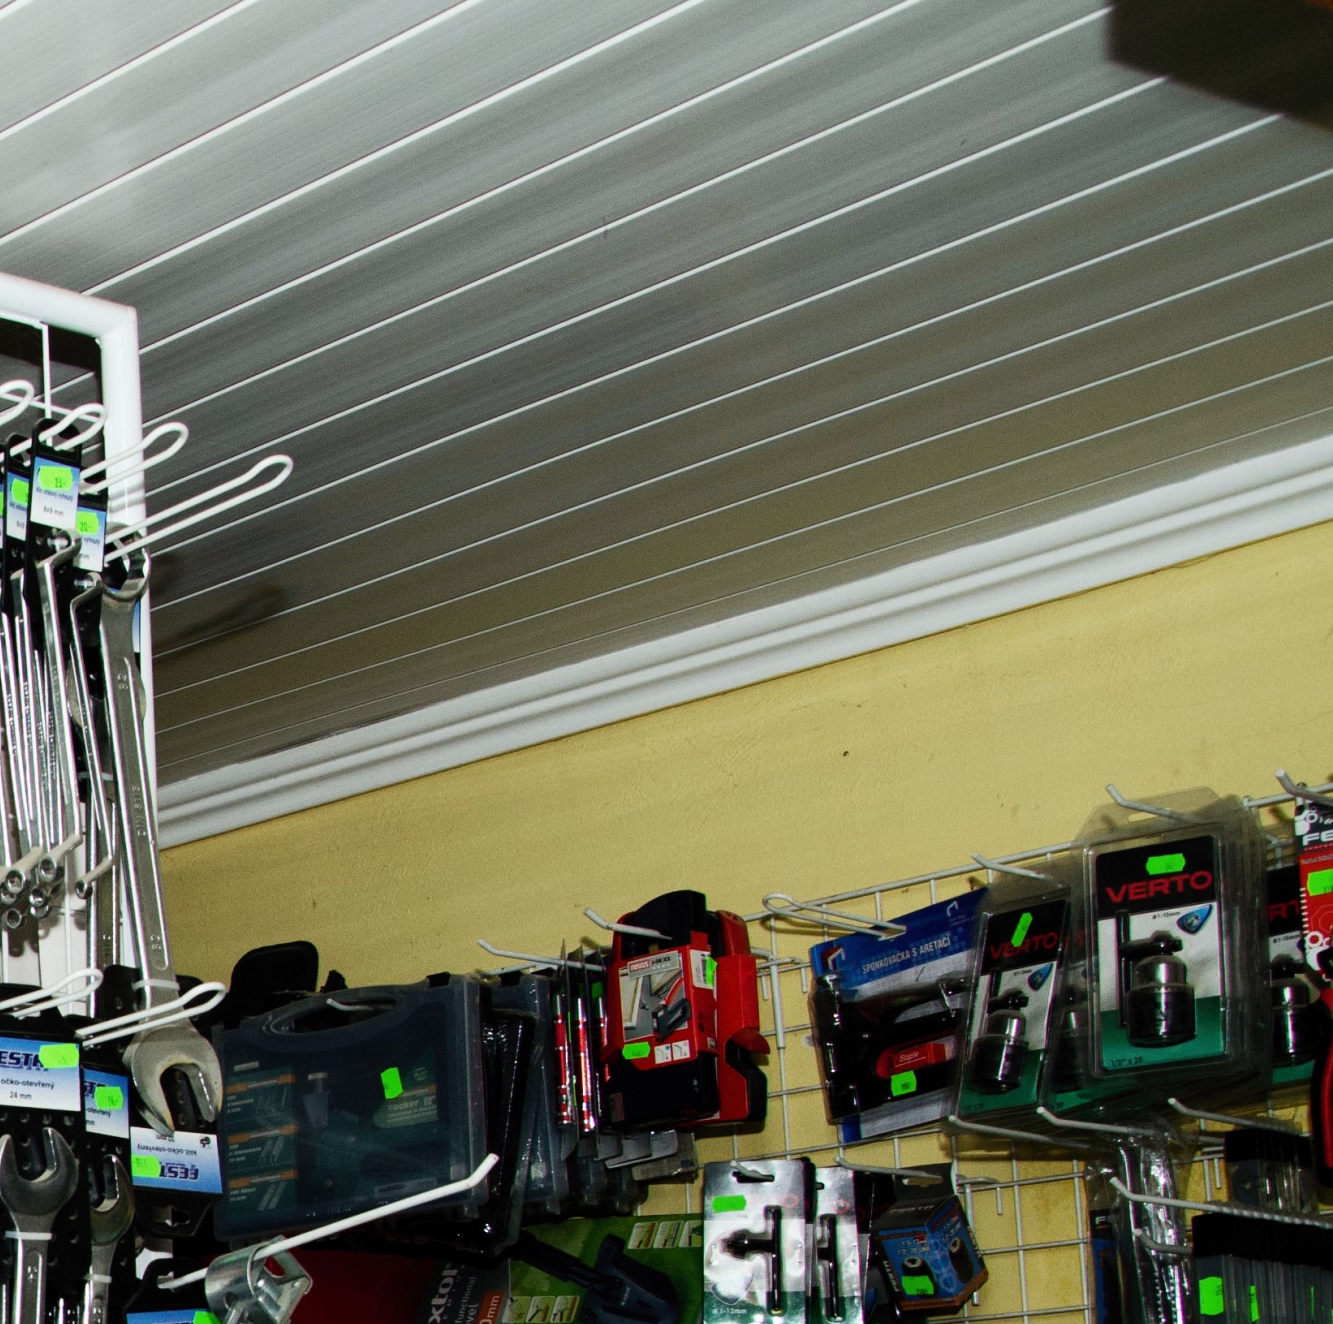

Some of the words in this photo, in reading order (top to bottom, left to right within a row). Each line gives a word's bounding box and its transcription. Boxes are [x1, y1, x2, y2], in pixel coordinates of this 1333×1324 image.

[1105, 870, 1213, 903] VERTO
[861, 950, 911, 975] SPONKOVAČKA
[918, 935, 951, 958] ARETACÍ
[0, 1077, 55, 1090] očko-otevřený
